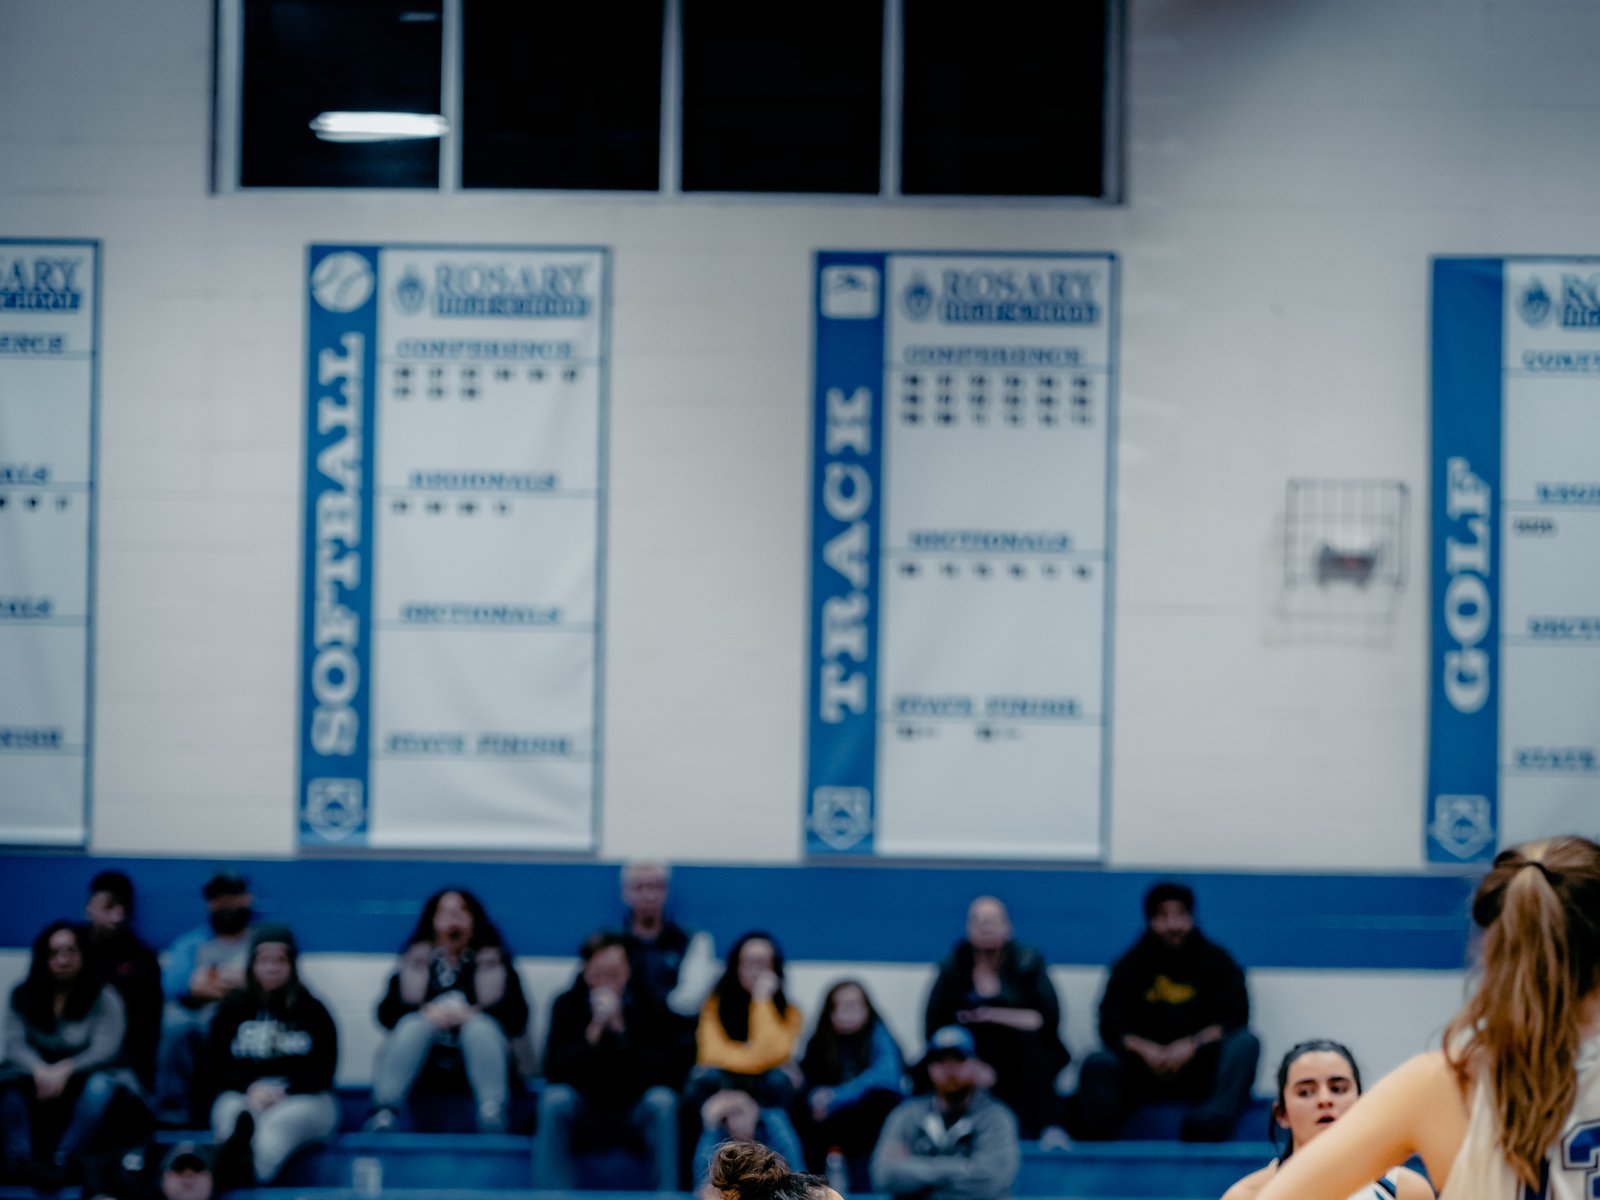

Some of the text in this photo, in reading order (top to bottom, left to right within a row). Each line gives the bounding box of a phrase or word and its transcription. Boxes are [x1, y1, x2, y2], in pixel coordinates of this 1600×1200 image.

[0, 258, 82, 292] ARY
[435, 263, 588, 298] ROSARY
[941, 269, 1098, 302] ROSARY
[311, 331, 365, 757] SOFTBALL
[819, 386, 873, 724] TRACK
[1444, 456, 1492, 714] GOLF
